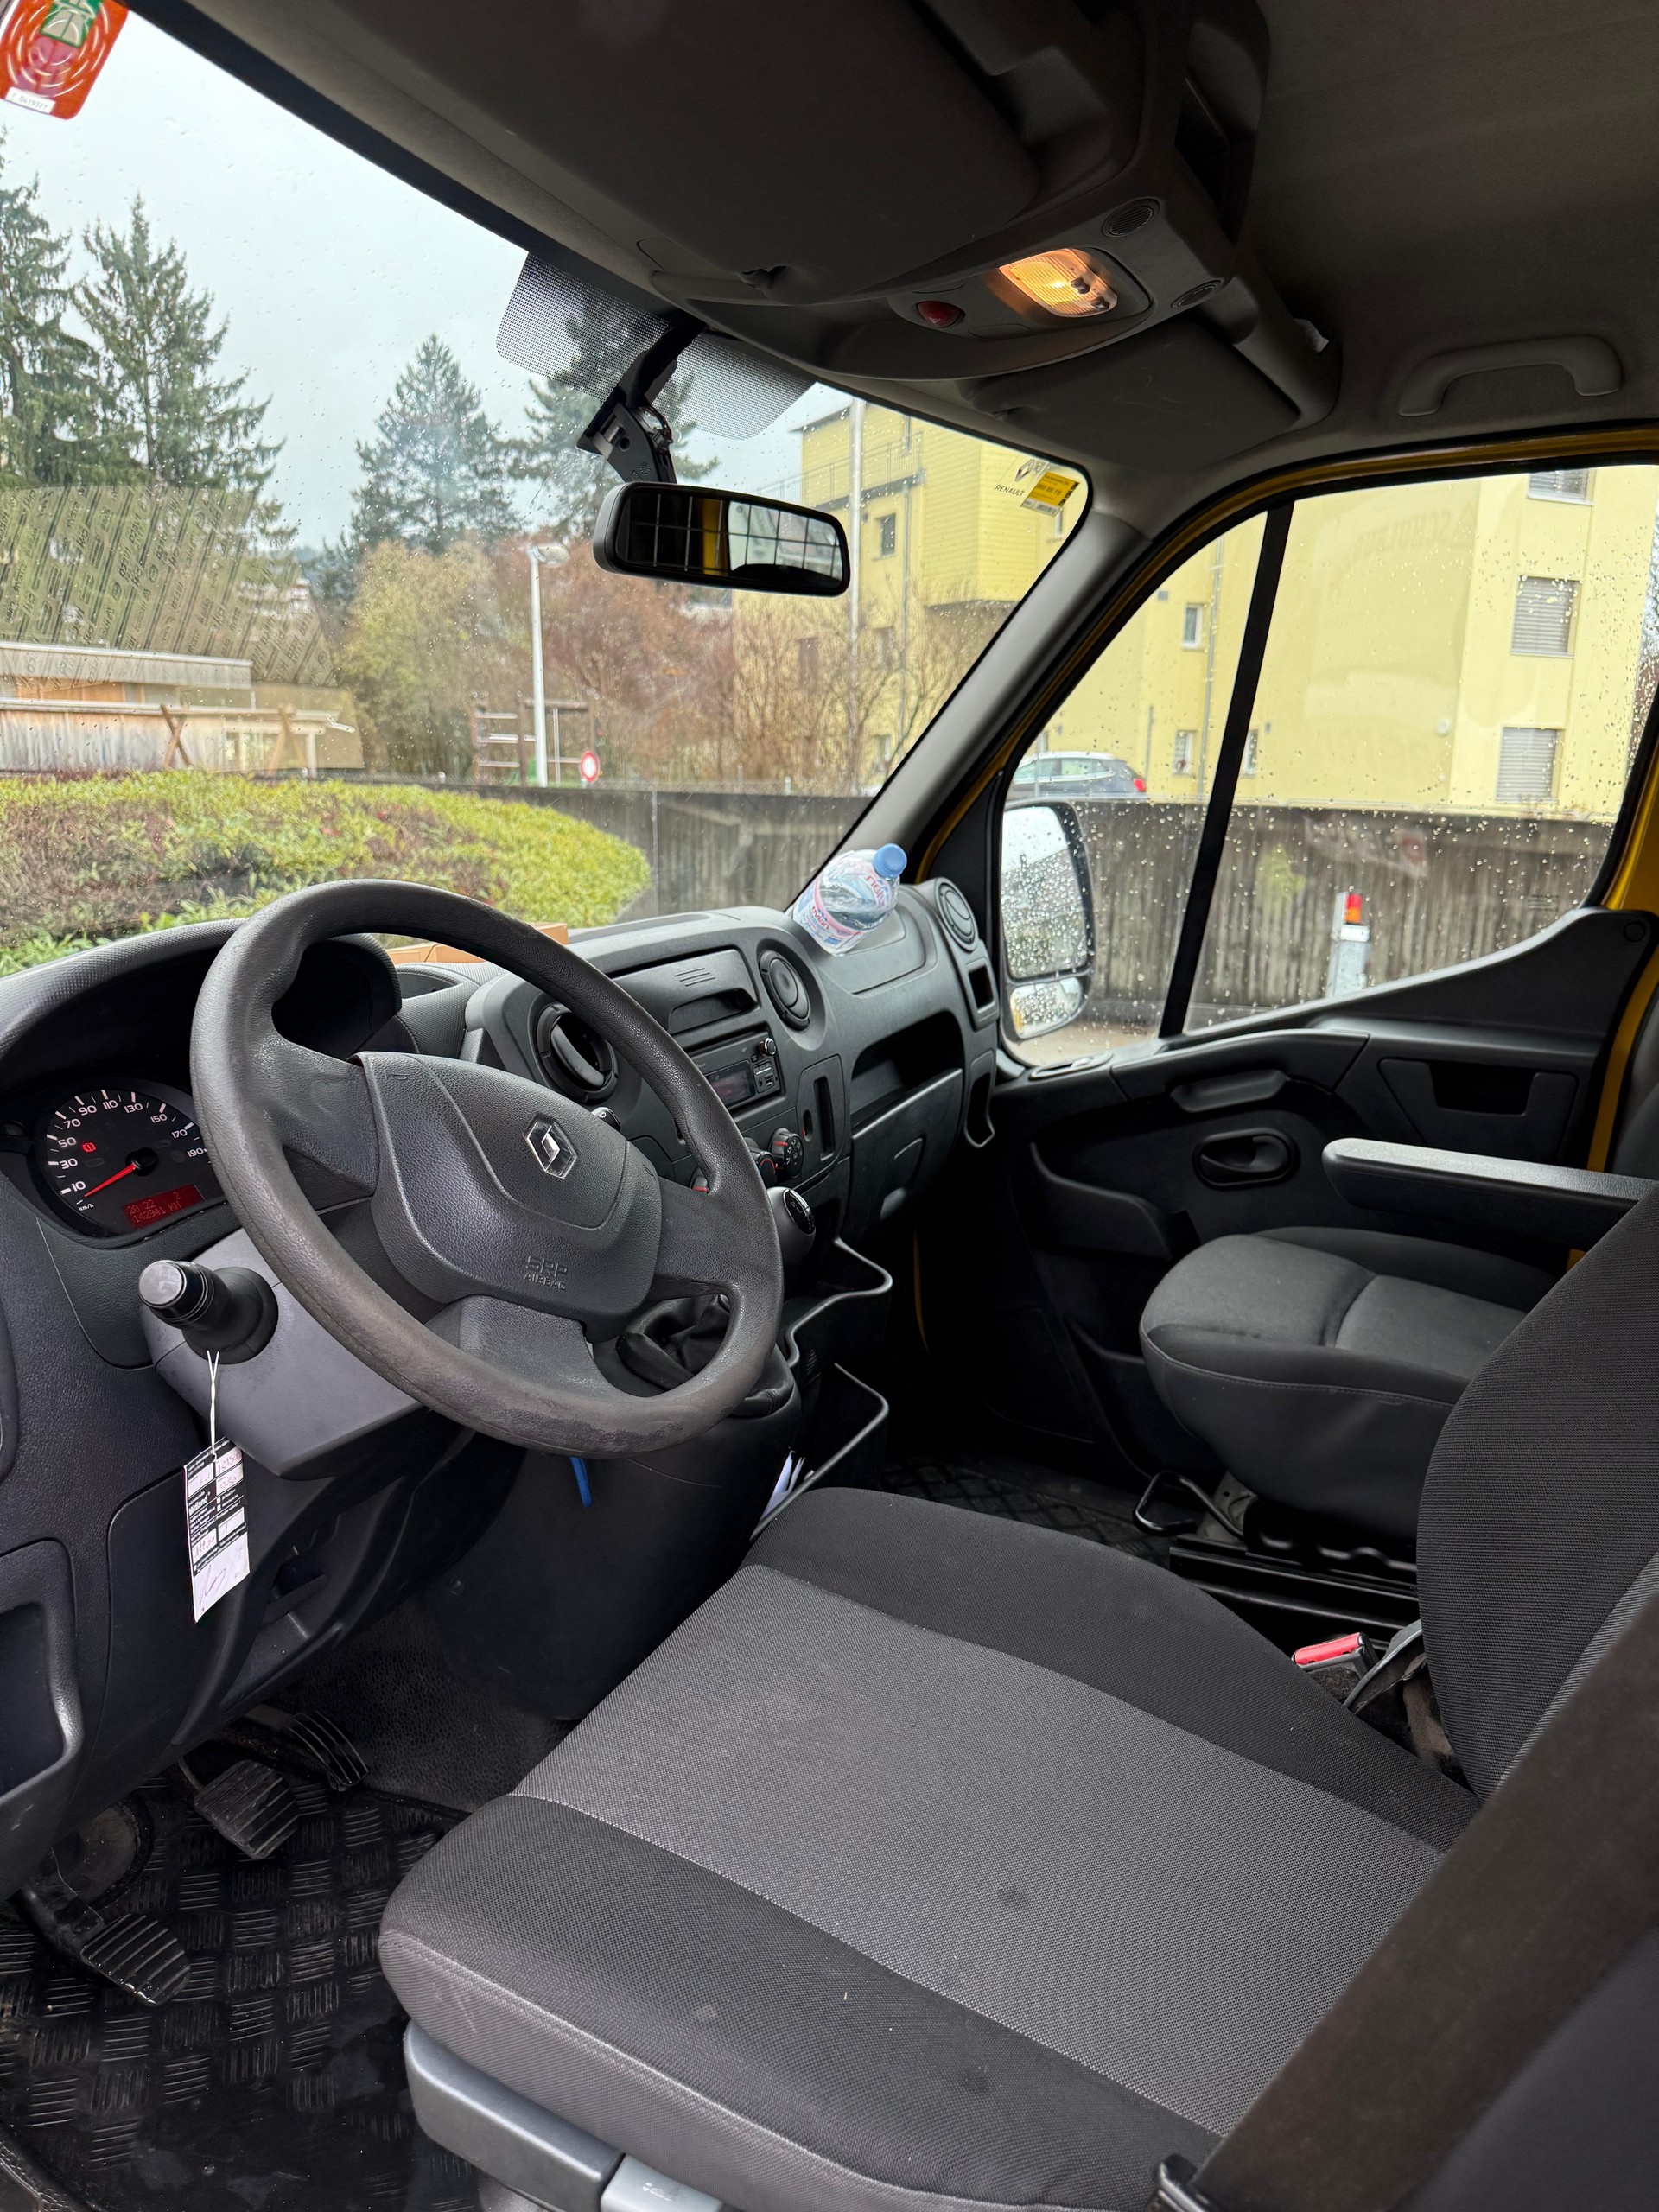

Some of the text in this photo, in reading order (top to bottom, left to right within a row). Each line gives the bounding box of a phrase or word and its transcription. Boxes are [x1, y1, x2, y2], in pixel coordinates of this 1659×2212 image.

[995, 484, 1026, 497] RENAULT
[102, 1099, 118, 1110] 110
[124, 1103, 143, 1114] 130
[78, 1105, 98, 1116] 90
[63, 1118, 81, 1129] 70
[149, 1113, 168, 1123] 150
[171, 1128, 188, 1139] 170
[57, 1136, 77, 1148] 50
[187, 1147, 204, 1158] 190
[59, 1158, 79, 1170] 30
[71, 1180, 86, 1192] 10
[78, 1203, 94, 1211] km/h
[523, 1272, 567, 1291] AIRBAG
